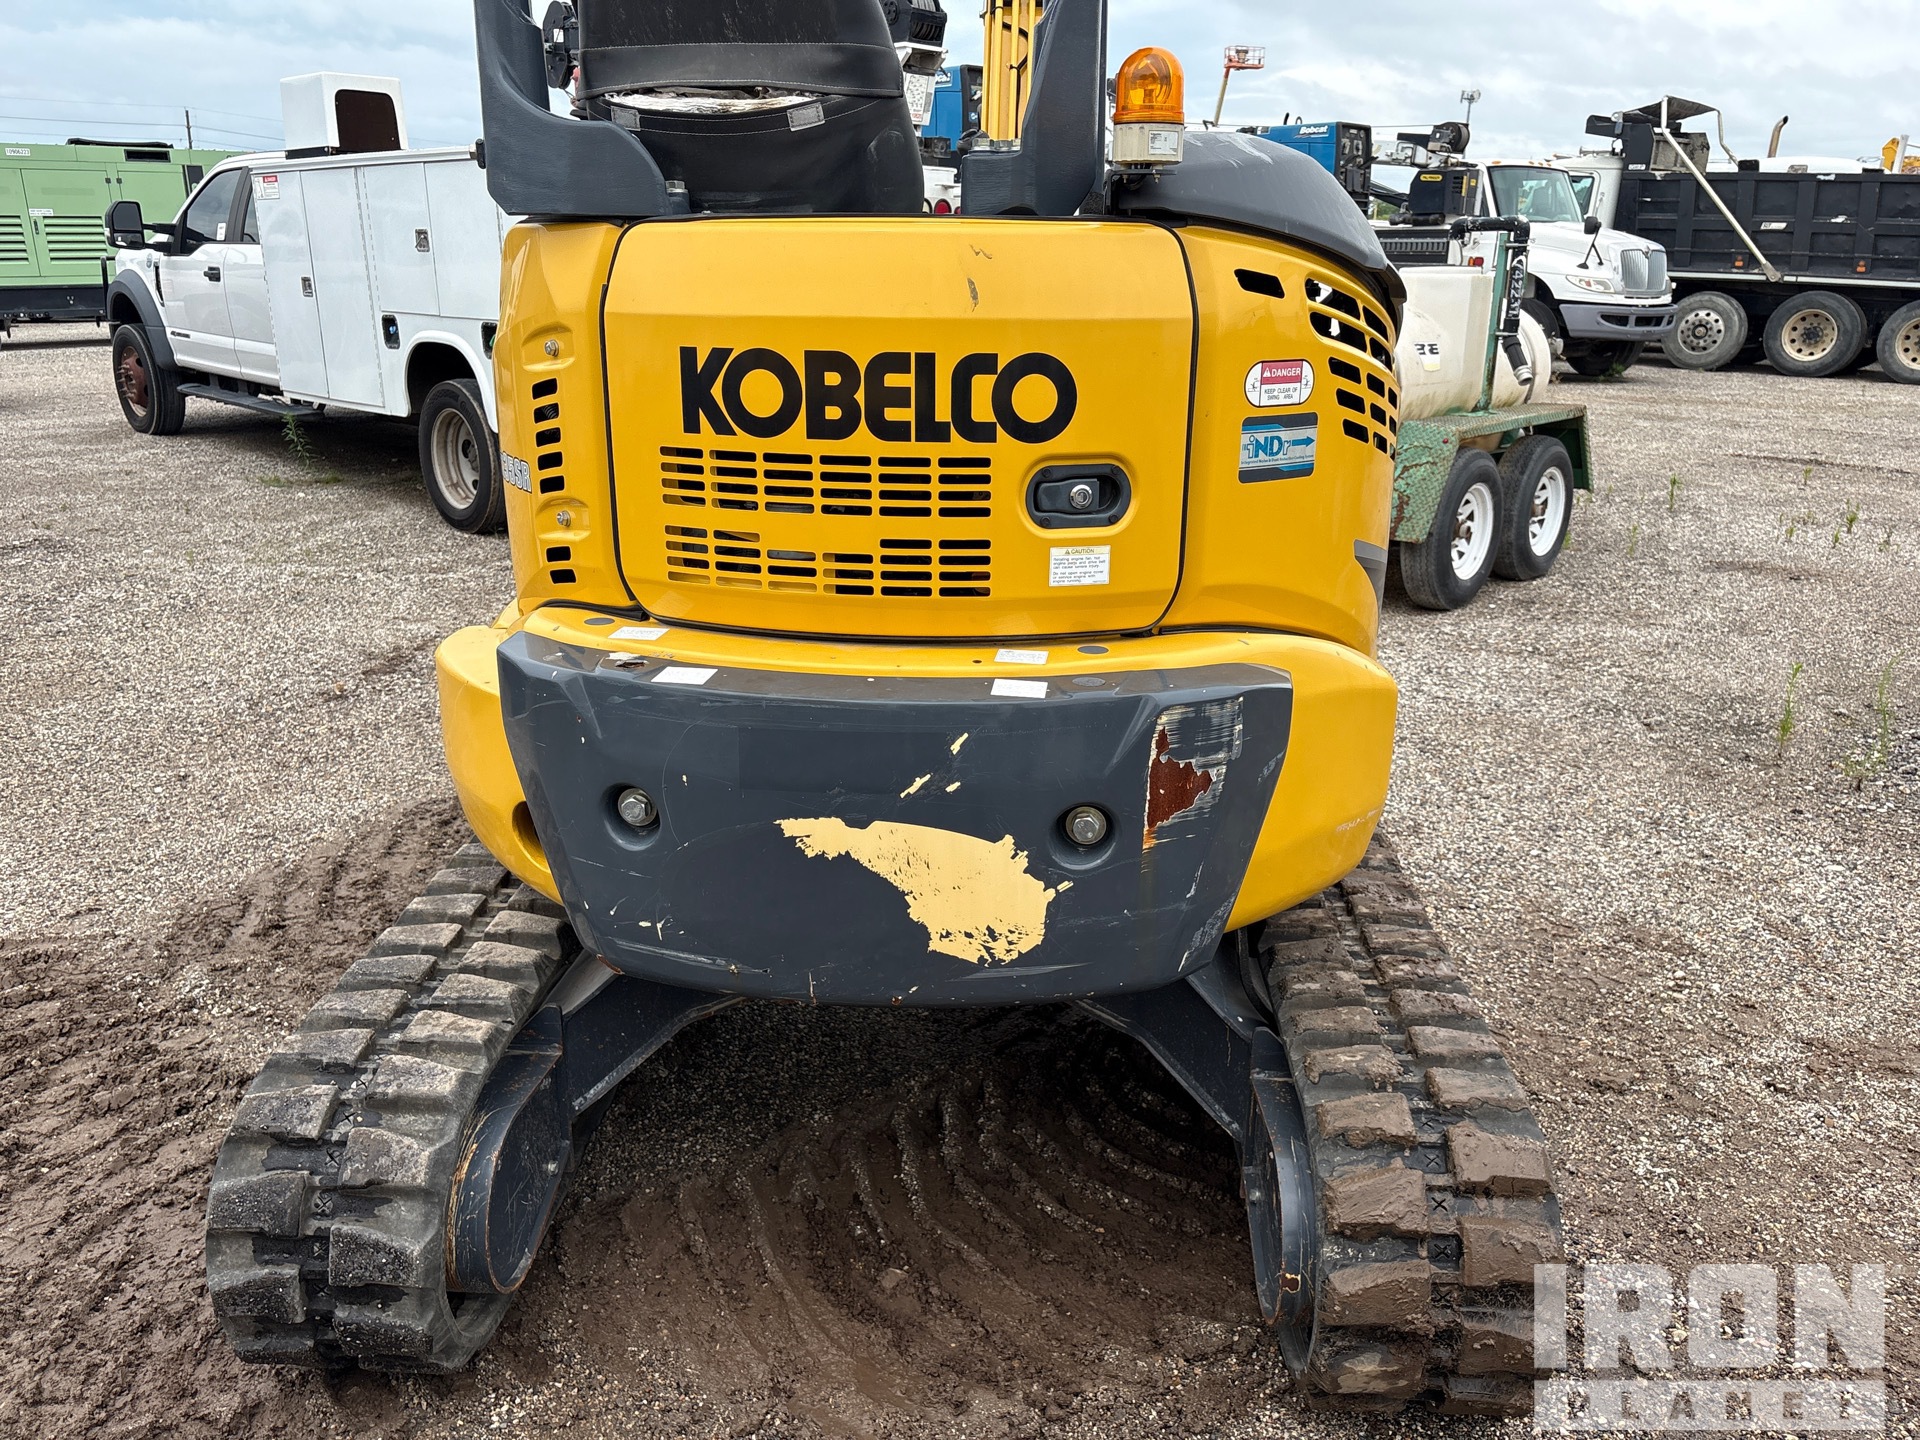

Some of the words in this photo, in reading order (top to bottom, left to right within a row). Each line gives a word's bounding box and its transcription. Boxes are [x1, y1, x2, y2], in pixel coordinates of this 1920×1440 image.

[1300, 125, 1328, 134] Bobcat
[1271, 368, 1301, 378] DANGER
[679, 345, 1078, 444] KOBELCO
[1246, 434, 1292, 459] iNDr
[500, 450, 532, 494] 35SR
